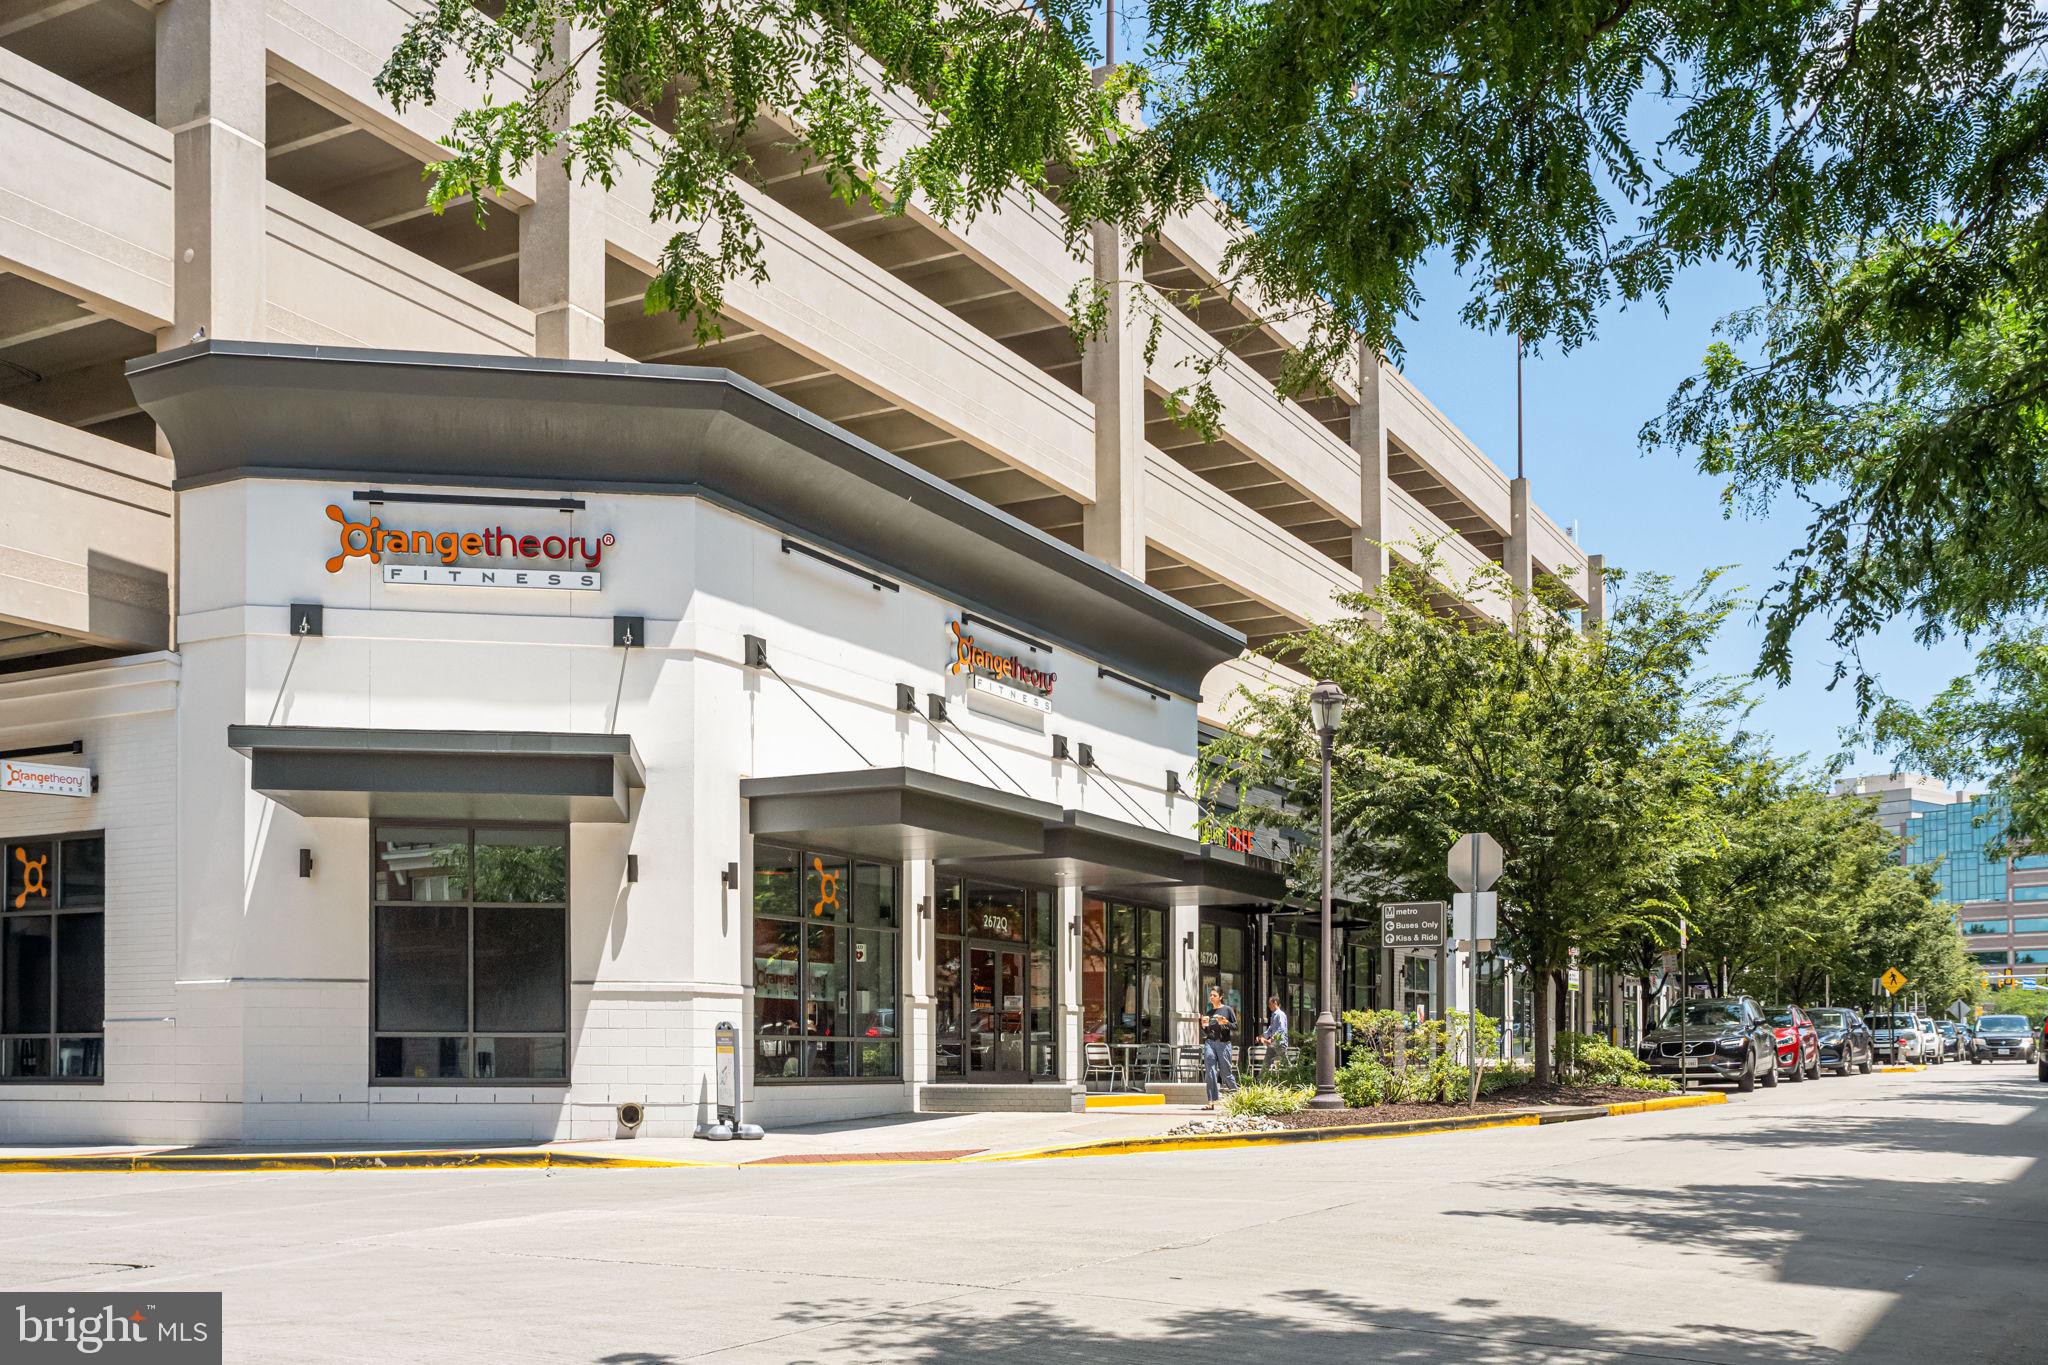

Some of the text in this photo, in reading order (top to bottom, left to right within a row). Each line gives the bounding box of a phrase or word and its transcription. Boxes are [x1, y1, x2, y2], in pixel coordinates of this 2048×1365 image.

[390, 568, 593, 586] FITNESS
[977, 679, 1050, 710] FITNESS
[22, 783, 82, 792] FITNESS
[983, 915, 1008, 932] 2672Q
[1421, 921, 1439, 929] Only
[1396, 934, 1412, 942] Kiss
[1413, 934, 1419, 942] &
